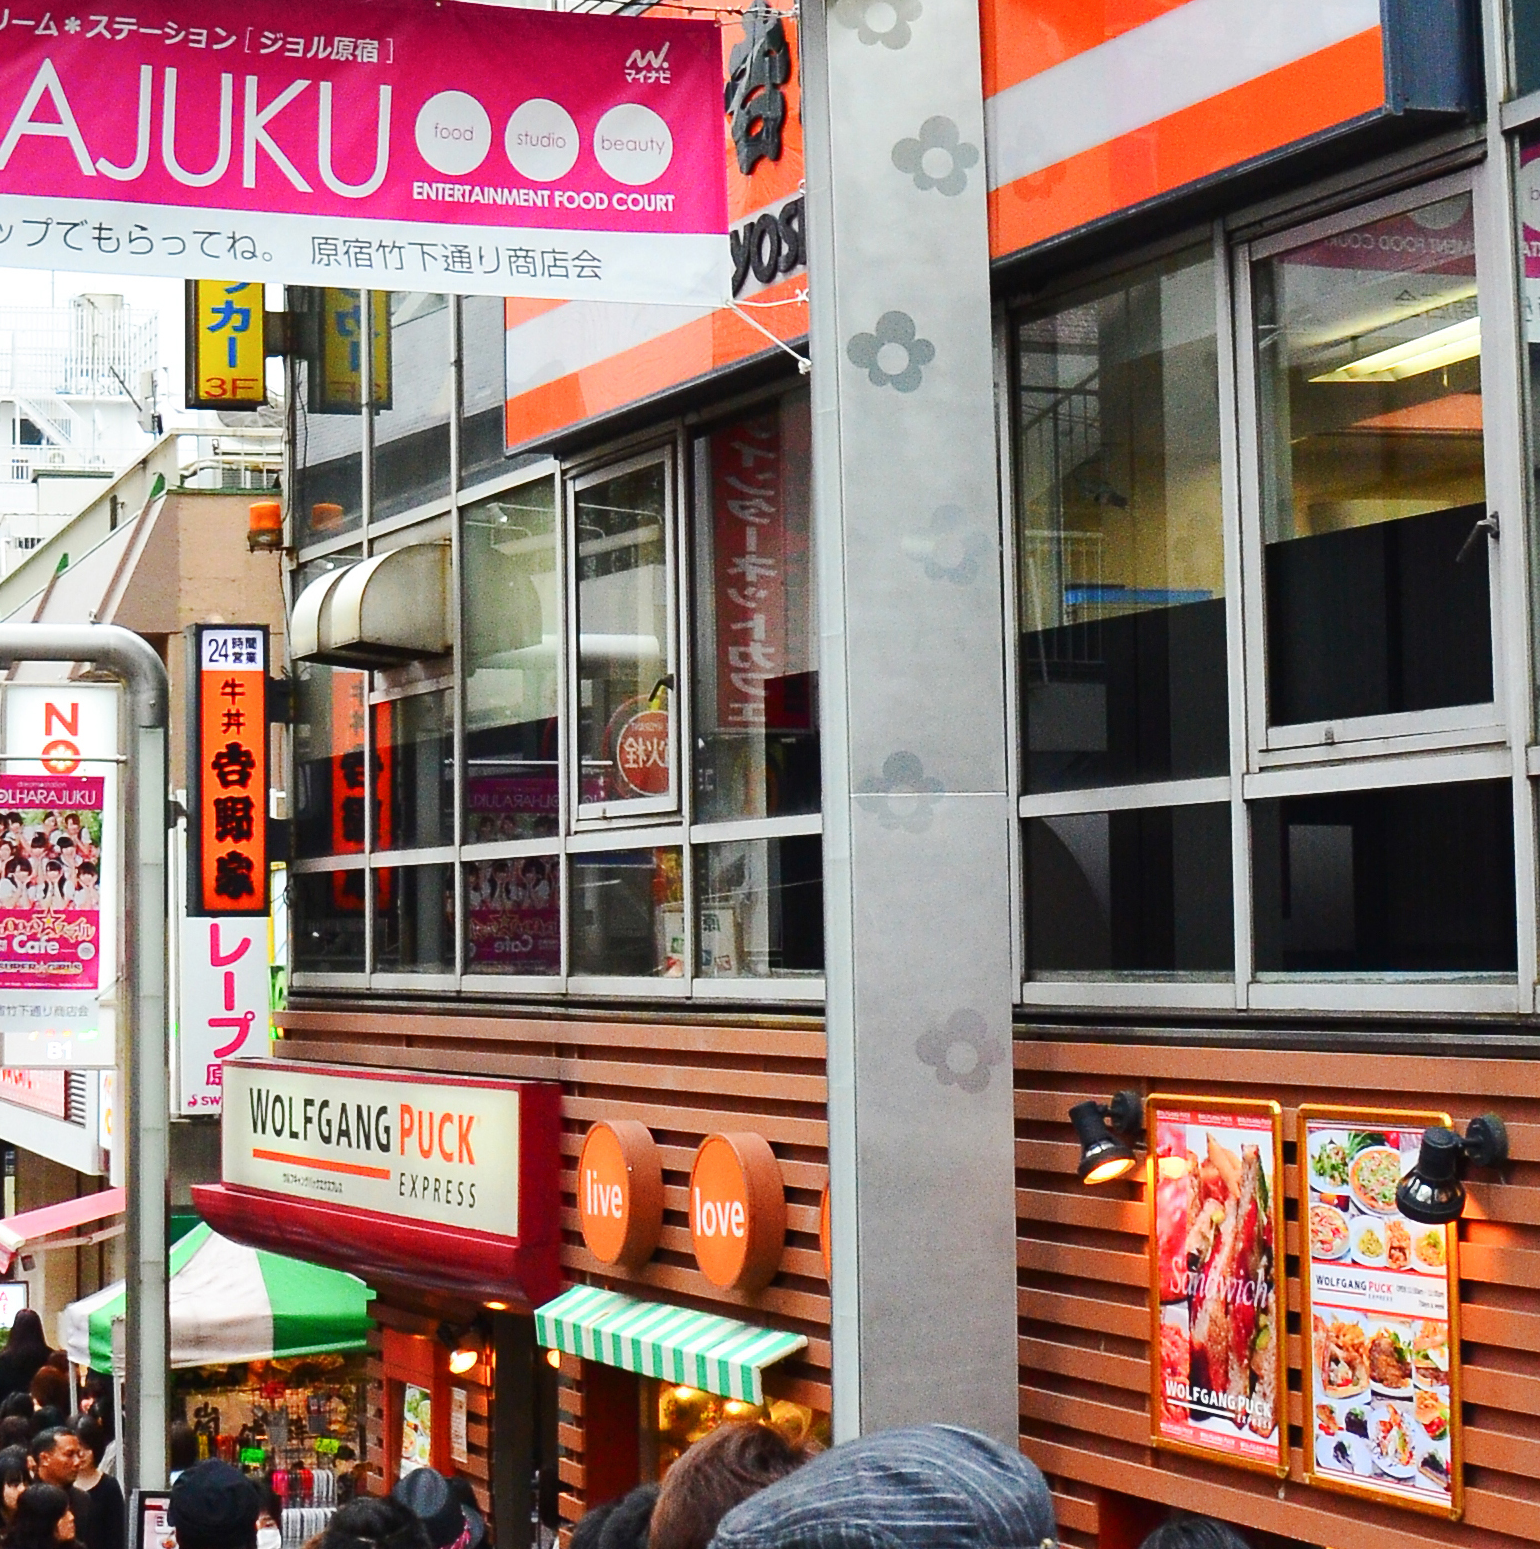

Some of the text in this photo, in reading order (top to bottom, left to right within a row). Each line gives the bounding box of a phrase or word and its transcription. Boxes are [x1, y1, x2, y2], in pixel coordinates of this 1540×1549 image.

[624, 69, 671, 85] マイナビ
[433, 119, 475, 142] food
[516, 129, 567, 152] studio
[600, 130, 666, 159] beauty
[412, 180, 674, 213] ENTERTAINMENT FOOD COURT
[310, 233, 603, 283] 原宿竹下通り商店会
[205, 378, 258, 399] 3F
[208, 638, 229, 663] 24
[220, 677, 247, 737] 牛丼
[12, 934, 60, 955] Cafe
[46, 1040, 73, 1060] B1
[249, 1087, 476, 1166] WOLFGANG PUCK
[399, 1171, 478, 1210] EXPRESS
[585, 1169, 623, 1220] live
[694, 1186, 745, 1239] love
[1169, 1255, 1269, 1310] Sandwich
[1315, 1274, 1367, 1292] WOLFGANG
[1368, 1281, 1393, 1294] PUCK
[1165, 1379, 1272, 1420] WOLFGANG PUCK
